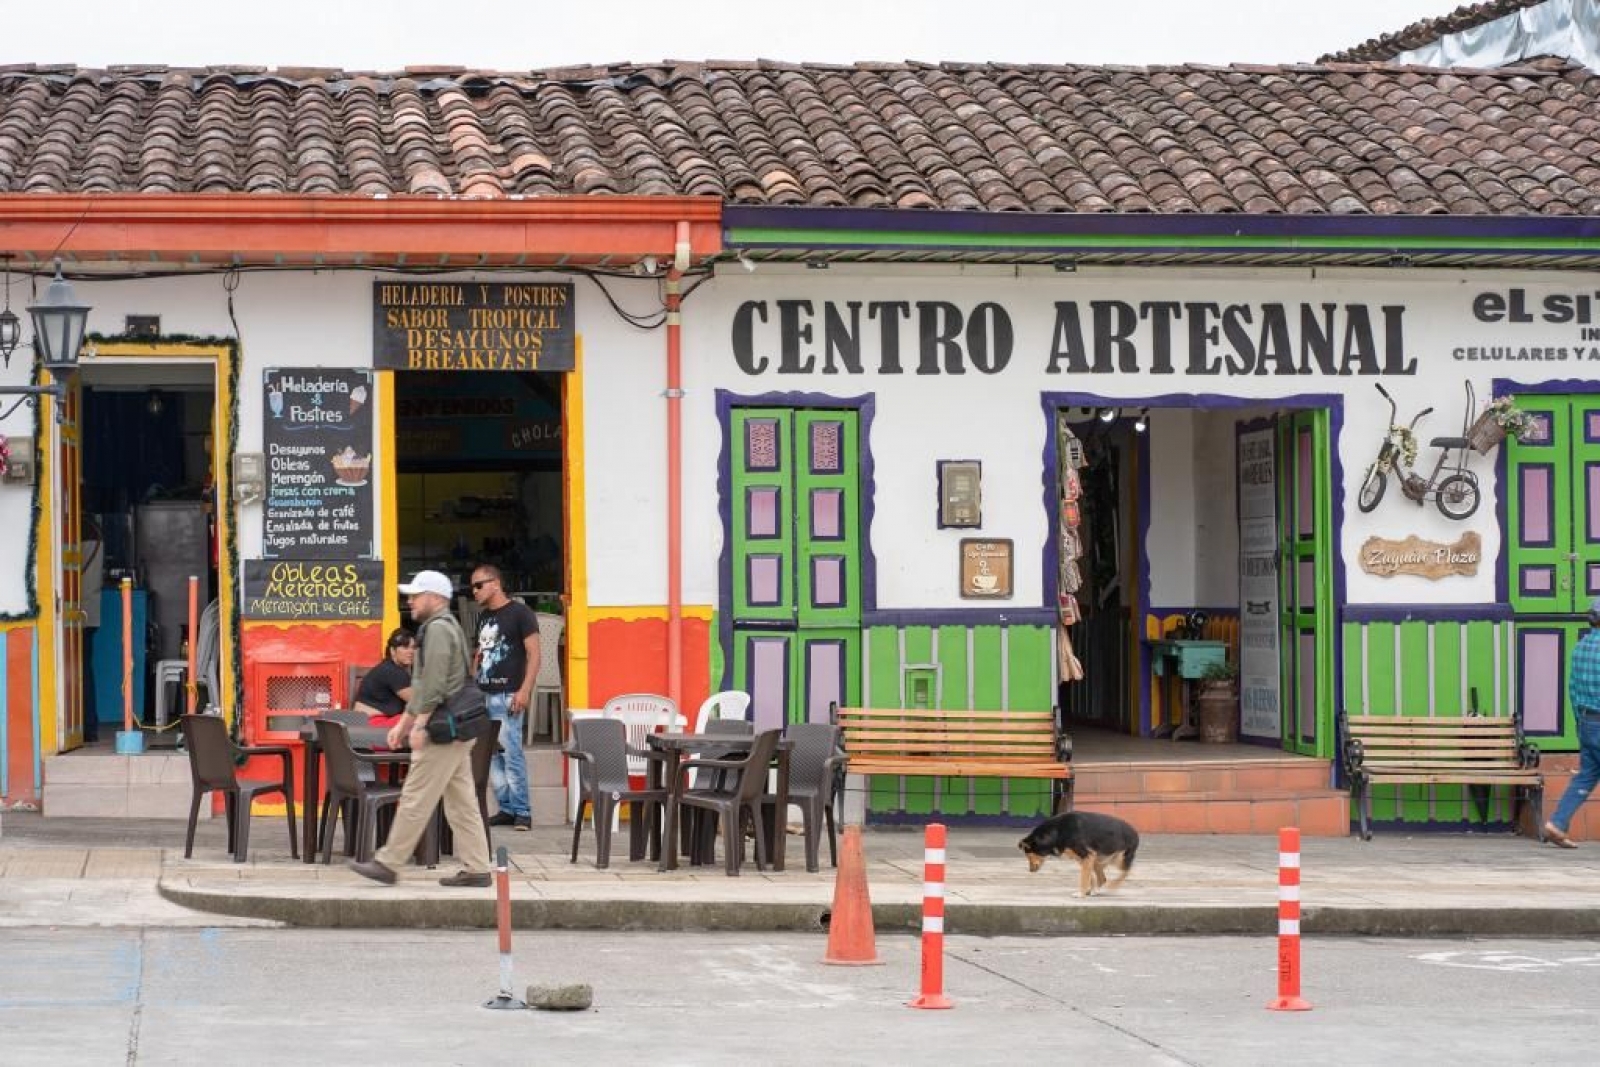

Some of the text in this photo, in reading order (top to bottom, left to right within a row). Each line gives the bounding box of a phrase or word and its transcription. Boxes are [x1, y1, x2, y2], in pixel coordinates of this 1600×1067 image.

[381, 285, 567, 306] HELADERIA Y POSTRES
[387, 308, 560, 329] SABOR TROPICAL
[407, 329, 543, 349] DESAYUNOS
[731, 299, 1418, 377] CENTRO ARTESANAL
[408, 349, 542, 370] BREAKFAST
[1452, 347, 1568, 361] CELULARES
[1573, 347, 1585, 361] Y
[290, 405, 343, 422] Postres
[269, 443, 326, 456] Desayunos
[271, 457, 310, 471] Obleas
[271, 470, 326, 486] Merengón
[301, 488, 321, 496] con
[317, 507, 329, 518] de
[266, 520, 313, 532] Ensalada
[318, 520, 330, 531] de
[266, 534, 296, 549] Jugos
[1433, 547, 1477, 565] Plaza
